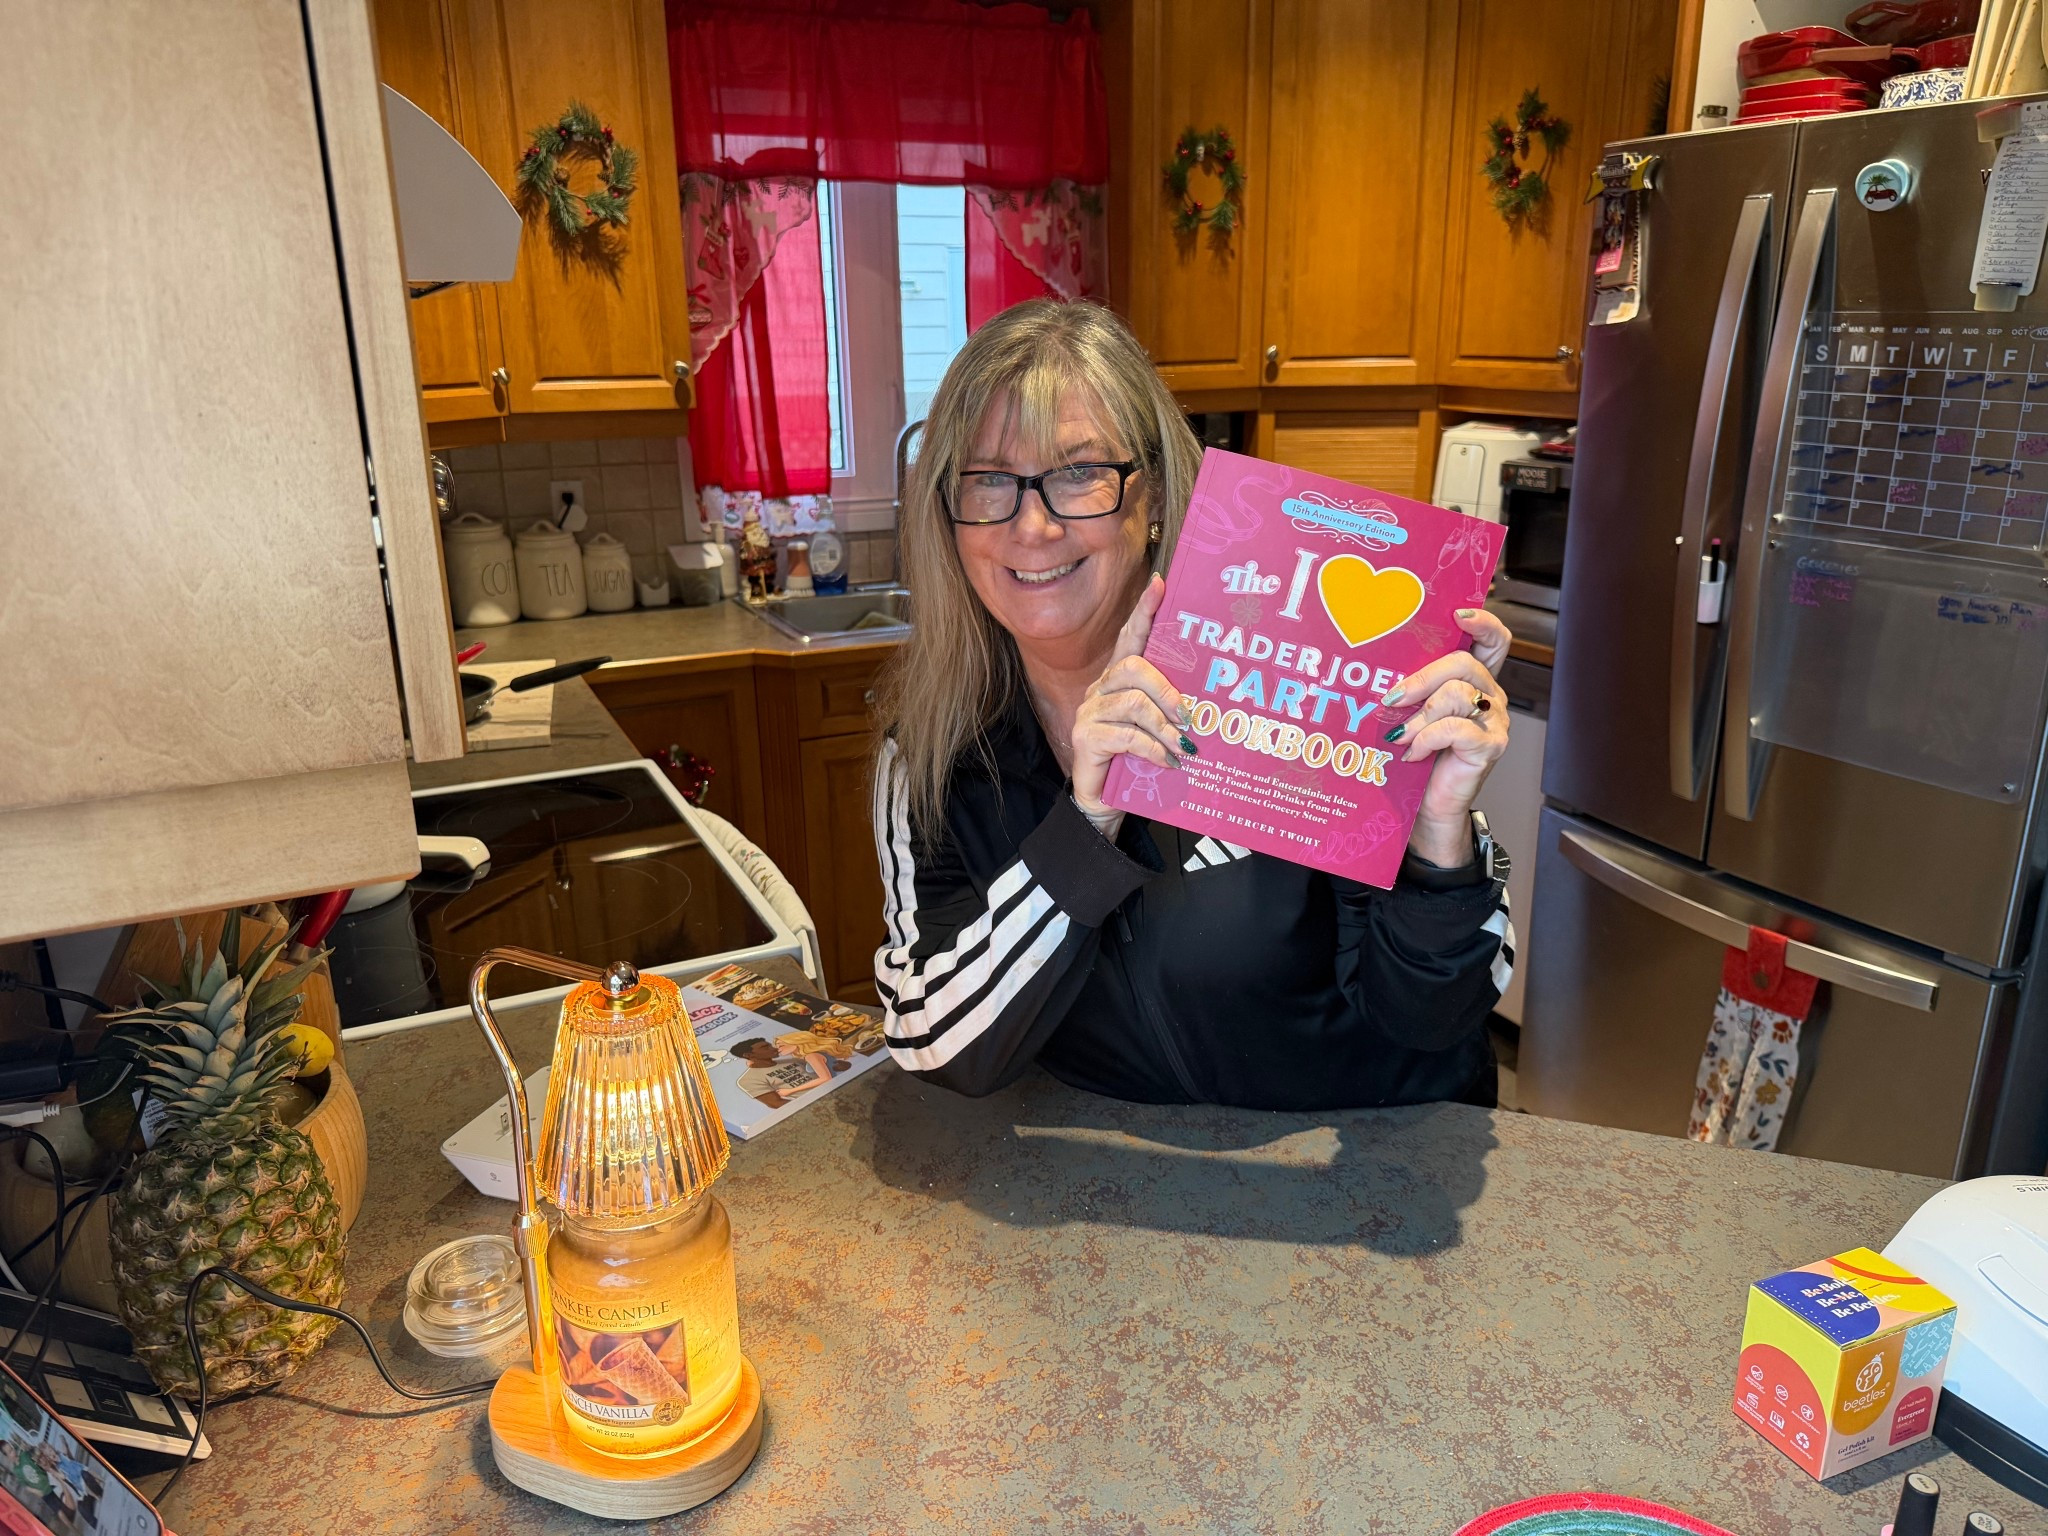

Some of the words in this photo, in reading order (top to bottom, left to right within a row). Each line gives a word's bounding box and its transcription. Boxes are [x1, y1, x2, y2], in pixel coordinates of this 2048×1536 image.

[1869, 326, 1886, 334] APR
[1938, 327, 1953, 335] JUL
[1815, 344, 1829, 362] S
[1849, 345, 1868, 363] M
[1886, 346, 1900, 364] T
[1923, 347, 1945, 365] W
[1963, 348, 1978, 367] T
[2003, 349, 2019, 368] F
[1292, 503, 1310, 516] 15th
[1311, 509, 1364, 531] Anniversary
[1365, 523, 1396, 539] Edition
[538, 562, 575, 597] TEA
[1221, 561, 1281, 595] The
[1277, 548, 1320, 621] I
[1177, 611, 1323, 678] TRADER
[1322, 655, 1405, 695] JOE'
[1203, 656, 1379, 734] PARTY
[1179, 762, 1201, 777] sing
[1201, 770, 1224, 784] Only
[1225, 776, 1252, 791] Foods
[1253, 785, 1272, 796] and
[1272, 790, 1305, 806] Drinks
[1306, 800, 1331, 814] from
[1331, 808, 1348, 819] the
[1215, 761, 1251, 779] Recipes
[1252, 773, 1271, 784] and
[1271, 778, 1332, 803] Entertaining
[1333, 794, 1358, 809] Ideas
[1187, 776, 1220, 794] World's
[1221, 787, 1262, 806] Greatest
[1263, 800, 1301, 819] Grocery
[1301, 812, 1329, 825] Store
[1179, 800, 1224, 819] CHERIE
[1226, 813, 1275, 835] MERCER
[1279, 828, 1322, 848] TWOHY
[689, 1005, 725, 1021] LICK
[694, 1012, 739, 1037] OKBOOK
[766, 1069, 786, 1078] REAL
[776, 1069, 801, 1080] WATCH
[1800, 1288, 1824, 1298] Be
[1815, 1297, 1839, 1308] Be
[1833, 1290, 1864, 1302] Me,
[1830, 1308, 1854, 1318] Be
[1848, 1293, 1902, 1313] Beetles.
[597, 1300, 671, 1321] CANDLE
[594, 1403, 650, 1419] VANILLA
[1843, 1387, 1886, 1412] beetles
[1837, 1445, 1849, 1455] Gel
